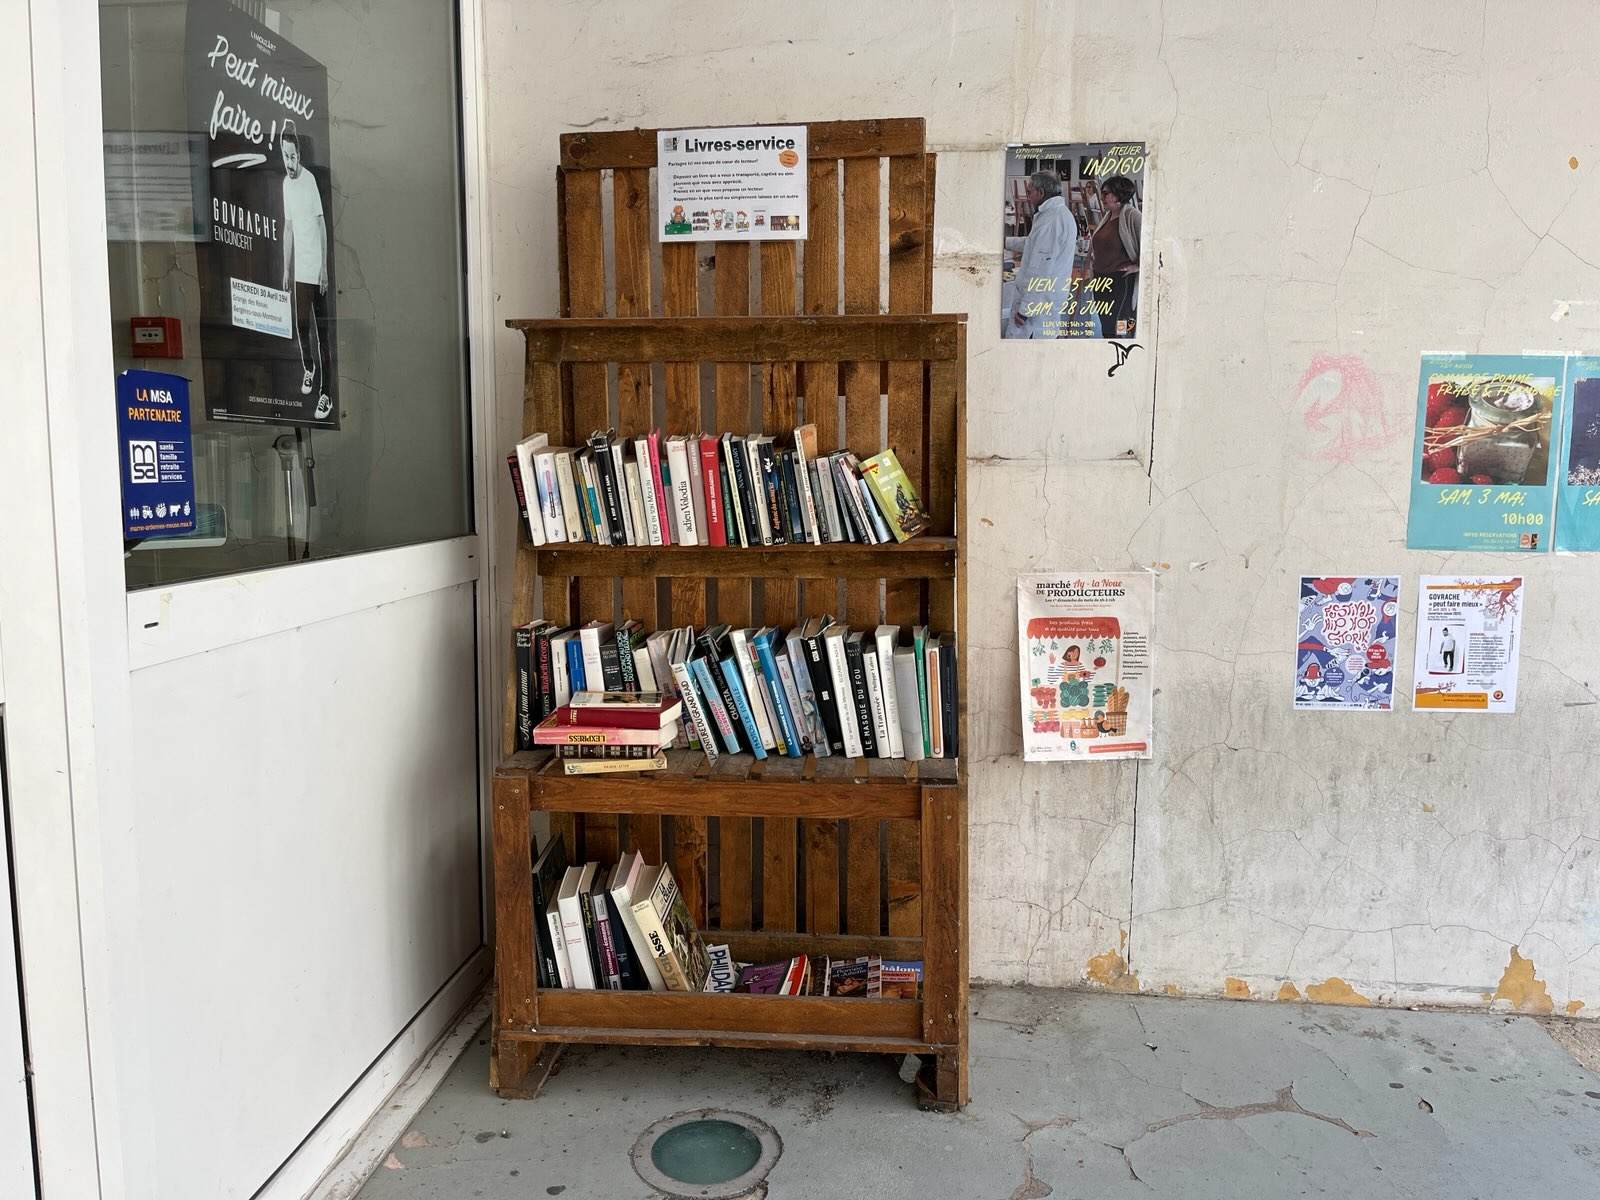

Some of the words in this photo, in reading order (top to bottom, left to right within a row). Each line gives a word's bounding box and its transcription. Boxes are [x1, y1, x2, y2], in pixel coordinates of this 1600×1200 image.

[208, 35, 259, 88] Peut
[261, 73, 314, 120] mieux
[210, 90, 264, 144] faire
[268, 120, 276, 151] !
[685, 136, 796, 153] Livres-service
[1107, 145, 1142, 156] ATELIER
[1083, 156, 1144, 177] INDIGO
[213, 197, 278, 241] GOVRACHE
[214, 224, 224, 242] EN
[224, 228, 253, 251] CONCERT
[232, 280, 259, 295] MERCREDI
[260, 288, 267, 298] 30
[267, 291, 279, 300] Avril
[1027, 277, 1058, 293] VEN.
[1062, 277, 1083, 292] 25
[1084, 276, 1114, 293] AVR.
[1025, 301, 1054, 317] SAM.
[1058, 300, 1078, 315] 28
[1080, 300, 1115, 316] JUIN.
[136, 388, 149, 402] LA
[150, 389, 174, 404] MSA
[128, 407, 182, 423] PARTENAIRE
[160, 453, 178, 461] famille
[160, 463, 180, 471] retraite
[161, 472, 183, 481] services
[736, 467, 745, 489] NANCY
[680, 480, 689, 508] Volodia
[1438, 488, 1473, 506] SAM.
[1478, 488, 1492, 505] 3
[682, 508, 692, 532] adieu
[1501, 512, 1544, 525] 10h00
[651, 523, 659, 533] ROI
[1036, 580, 1071, 589] marché
[1091, 579, 1100, 587] la
[1047, 588, 1126, 597] PRODUCTEURS
[1324, 602, 1375, 618] FESTIVAL
[1323, 617, 1347, 633] HIP
[1349, 617, 1376, 631] HOP
[1327, 631, 1368, 646] STORIK
[540, 639, 548, 662] George
[521, 668, 529, 693] amour
[541, 662, 549, 693] Elizabeth
[854, 669, 862, 685] FOU
[681, 681, 692, 696] RAID
[857, 689, 865, 700] DU
[686, 696, 701, 718] GRAND
[731, 687, 747, 713] FAMILLE
[859, 703, 870, 738] MASQUE
[874, 696, 885, 729] Traversée
[519, 709, 532, 740] Angel,
[699, 726, 718, 760] L'AVENTURE
[747, 724, 761, 749] PHOTOS
[880, 729, 886, 739] La
[865, 739, 873, 750] LE
[605, 946, 615, 975] Dictionnaire
[648, 930, 673, 976] CHASSE
